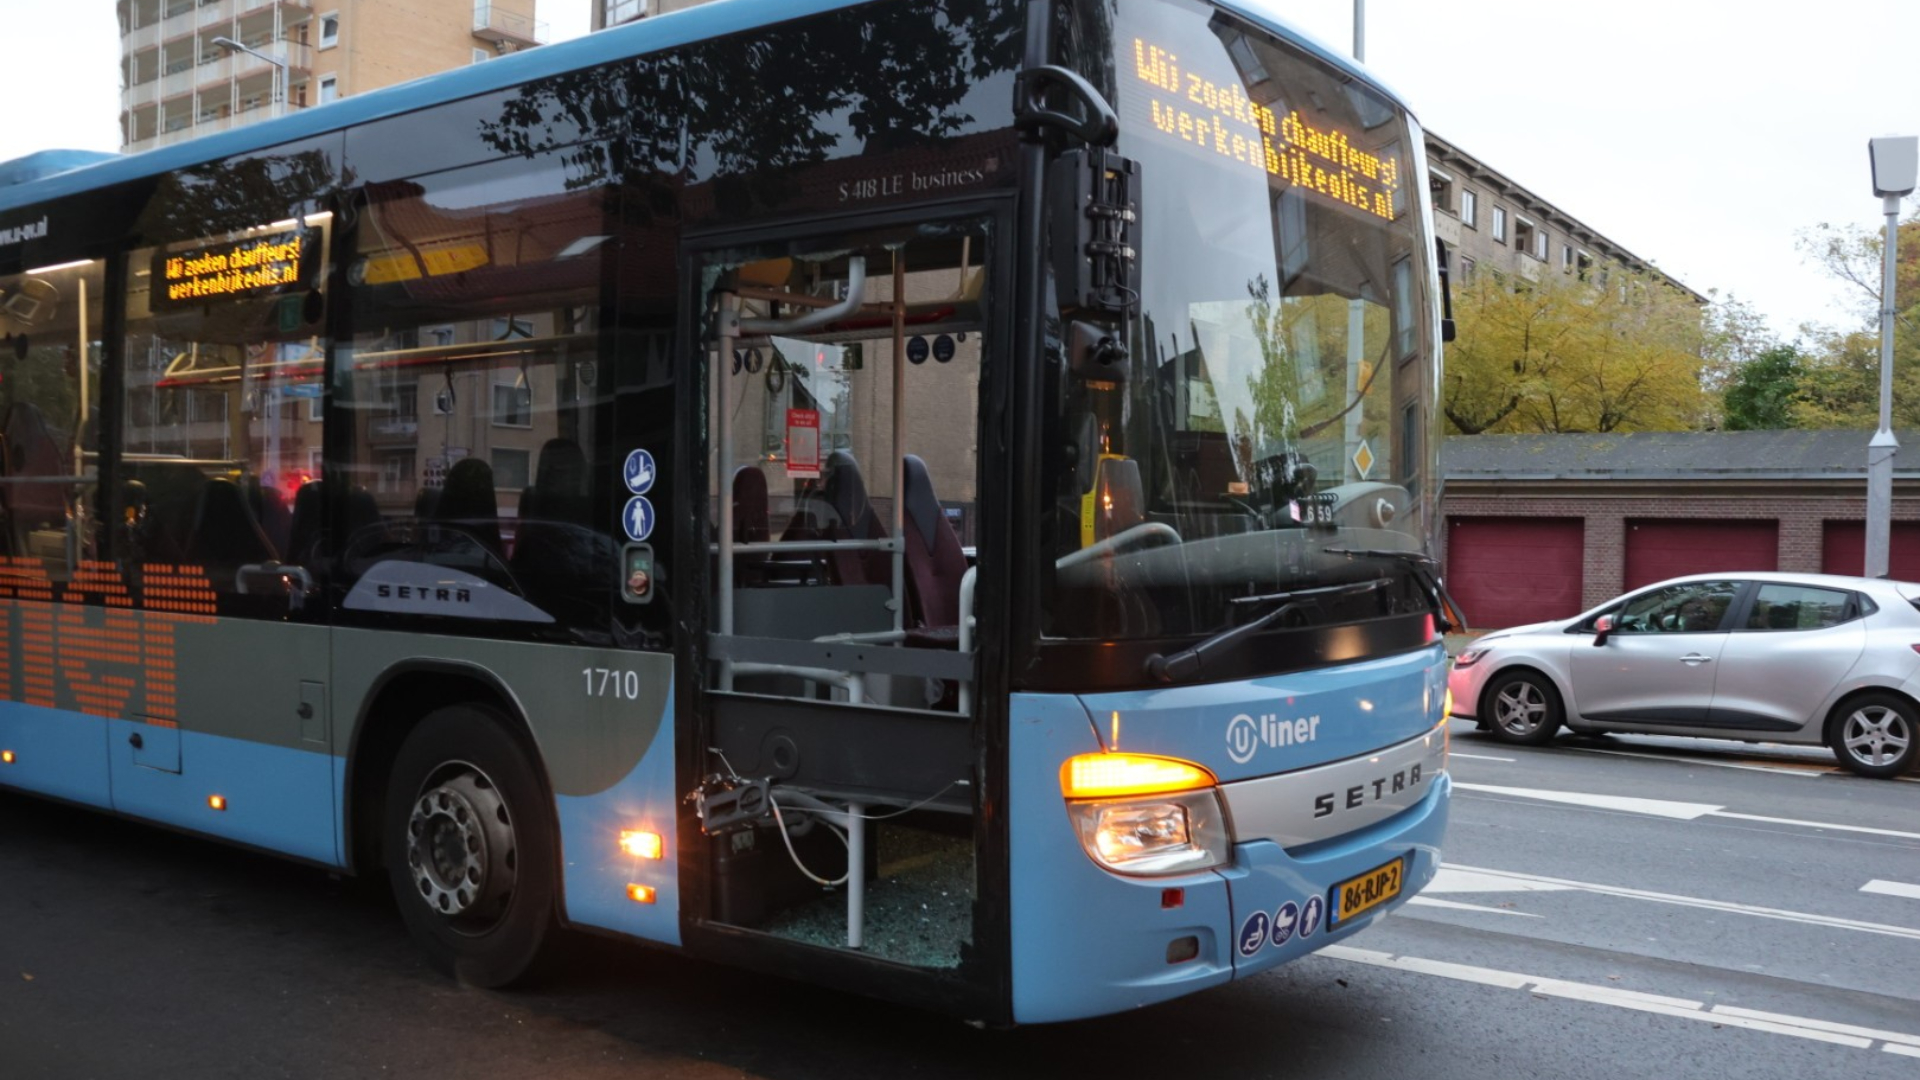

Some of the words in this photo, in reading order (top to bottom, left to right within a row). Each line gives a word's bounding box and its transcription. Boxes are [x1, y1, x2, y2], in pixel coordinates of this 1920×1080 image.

[1135, 38, 1179, 93] Wij
[1187, 72, 1276, 136] zoeken
[1282, 110, 1398, 189] chauffeurs!
[1152, 99, 1395, 221] werkenbijkeolis.nl
[838, 182, 849, 201] S
[852, 178, 877, 199] 418
[882, 174, 903, 196] LE
[912, 167, 984, 190] business
[377, 584, 471, 603] SETRA
[582, 667, 639, 700] 1710
[1260, 713, 1320, 749] liner
[1314, 763, 1422, 819] SETRA
[1344, 866, 1398, 914] 86-BJP-2
